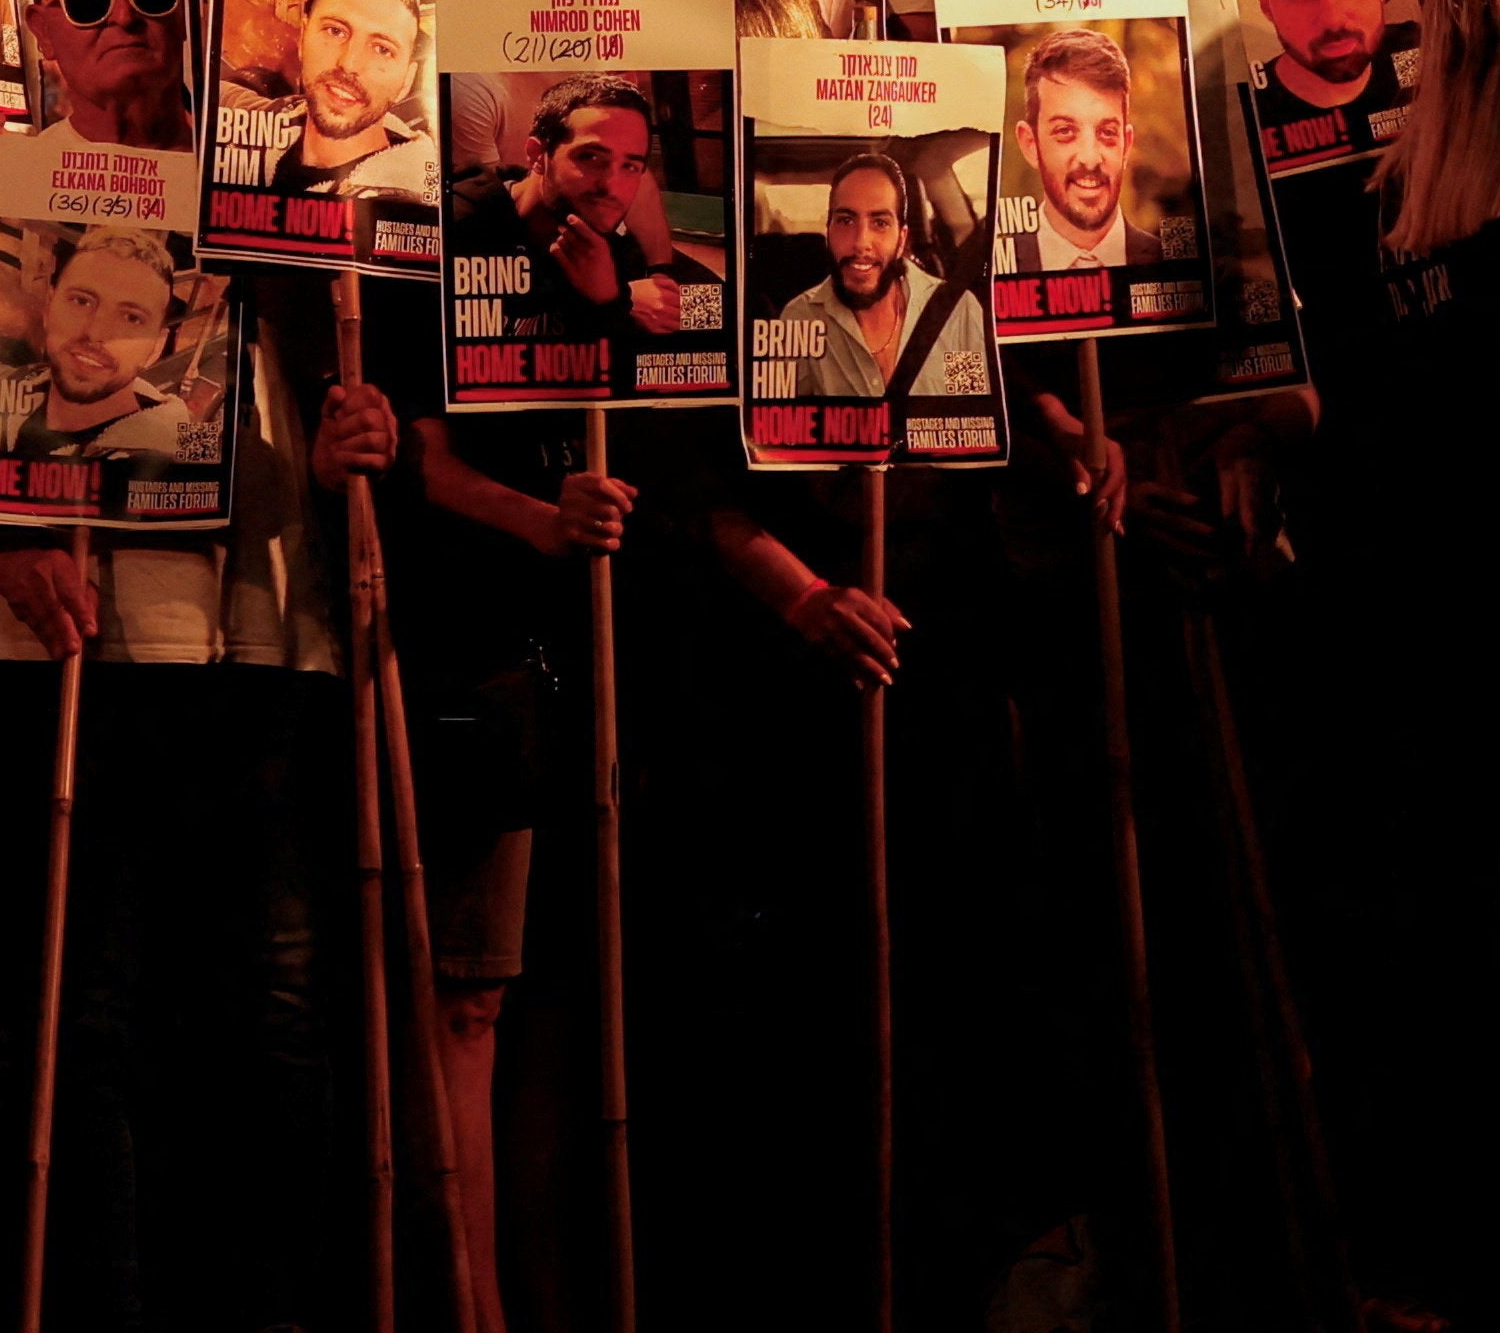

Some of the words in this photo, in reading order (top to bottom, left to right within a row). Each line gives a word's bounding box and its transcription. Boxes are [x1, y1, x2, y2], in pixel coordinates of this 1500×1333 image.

[530, 8, 589, 33] NIMROD
[593, 7, 640, 32] COHEN
[840, 54, 886, 78] צנגאוקר
[816, 77, 863, 102] MATAN
[867, 78, 936, 102] ZANGAUKER
[217, 107, 291, 148] BRING
[867, 103, 892, 129] (24)
[63, 151, 108, 171] בוחבוט
[113, 155, 158, 176] אלקנה
[214, 145, 261, 186] HIM
[52, 171, 106, 191] ELKANA
[110, 174, 165, 196] BOHBOT
[285, 198, 353, 239] NOW!
[454, 256, 530, 295] BRING
[454, 298, 502, 338] HIM
[753, 320, 826, 357] BRING
[457, 344, 529, 384] HOME
[534, 337, 609, 383] NOW!
[636, 354, 672, 368] HOSTAGES
[675, 354, 690, 366] AND
[692, 353, 726, 365] MISSING
[636, 367, 683, 385] FAMILIES
[687, 366, 727, 384] FORUM
[753, 362, 797, 399] HIM
[752, 406, 817, 445] HOME
[823, 401, 890, 443] NOW!
[907, 430, 953, 449] FAMILIES
[957, 429, 996, 447] FORUM
